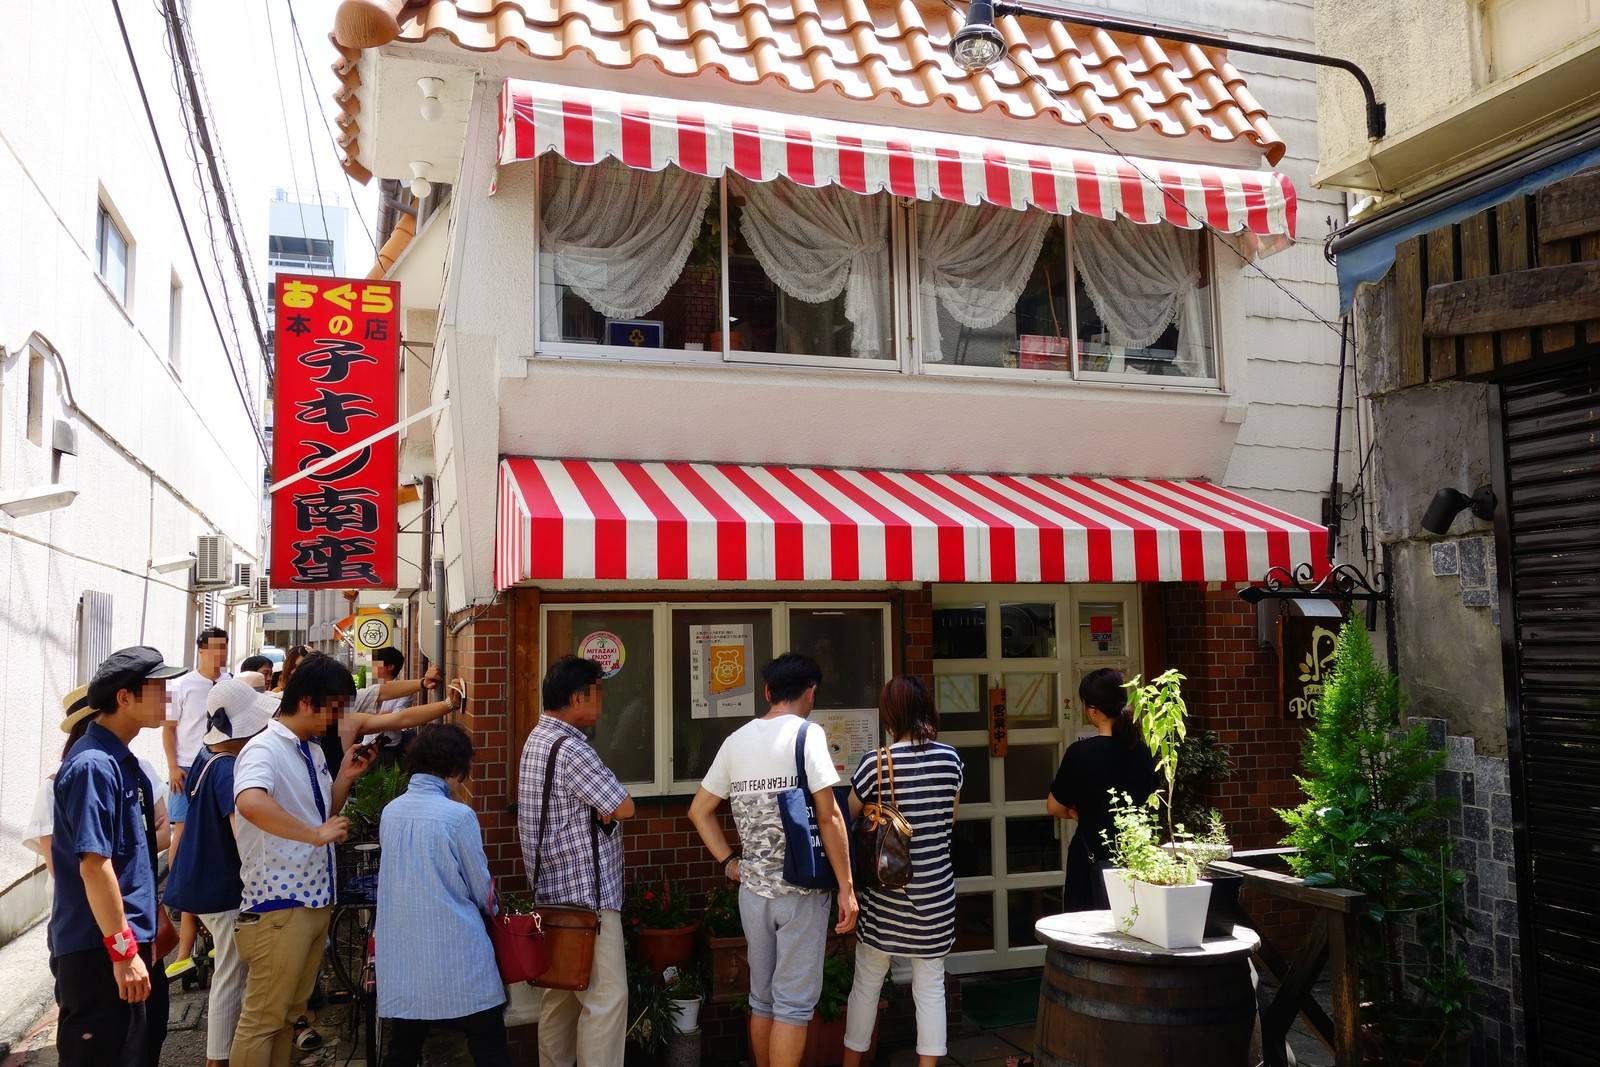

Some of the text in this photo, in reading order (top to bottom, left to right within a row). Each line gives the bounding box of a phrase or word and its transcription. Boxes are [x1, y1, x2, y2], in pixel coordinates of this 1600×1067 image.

[282, 280, 394, 314] おぐら
[290, 338, 383, 584] チキン南蛮
[748, 778, 766, 791] FEAR
